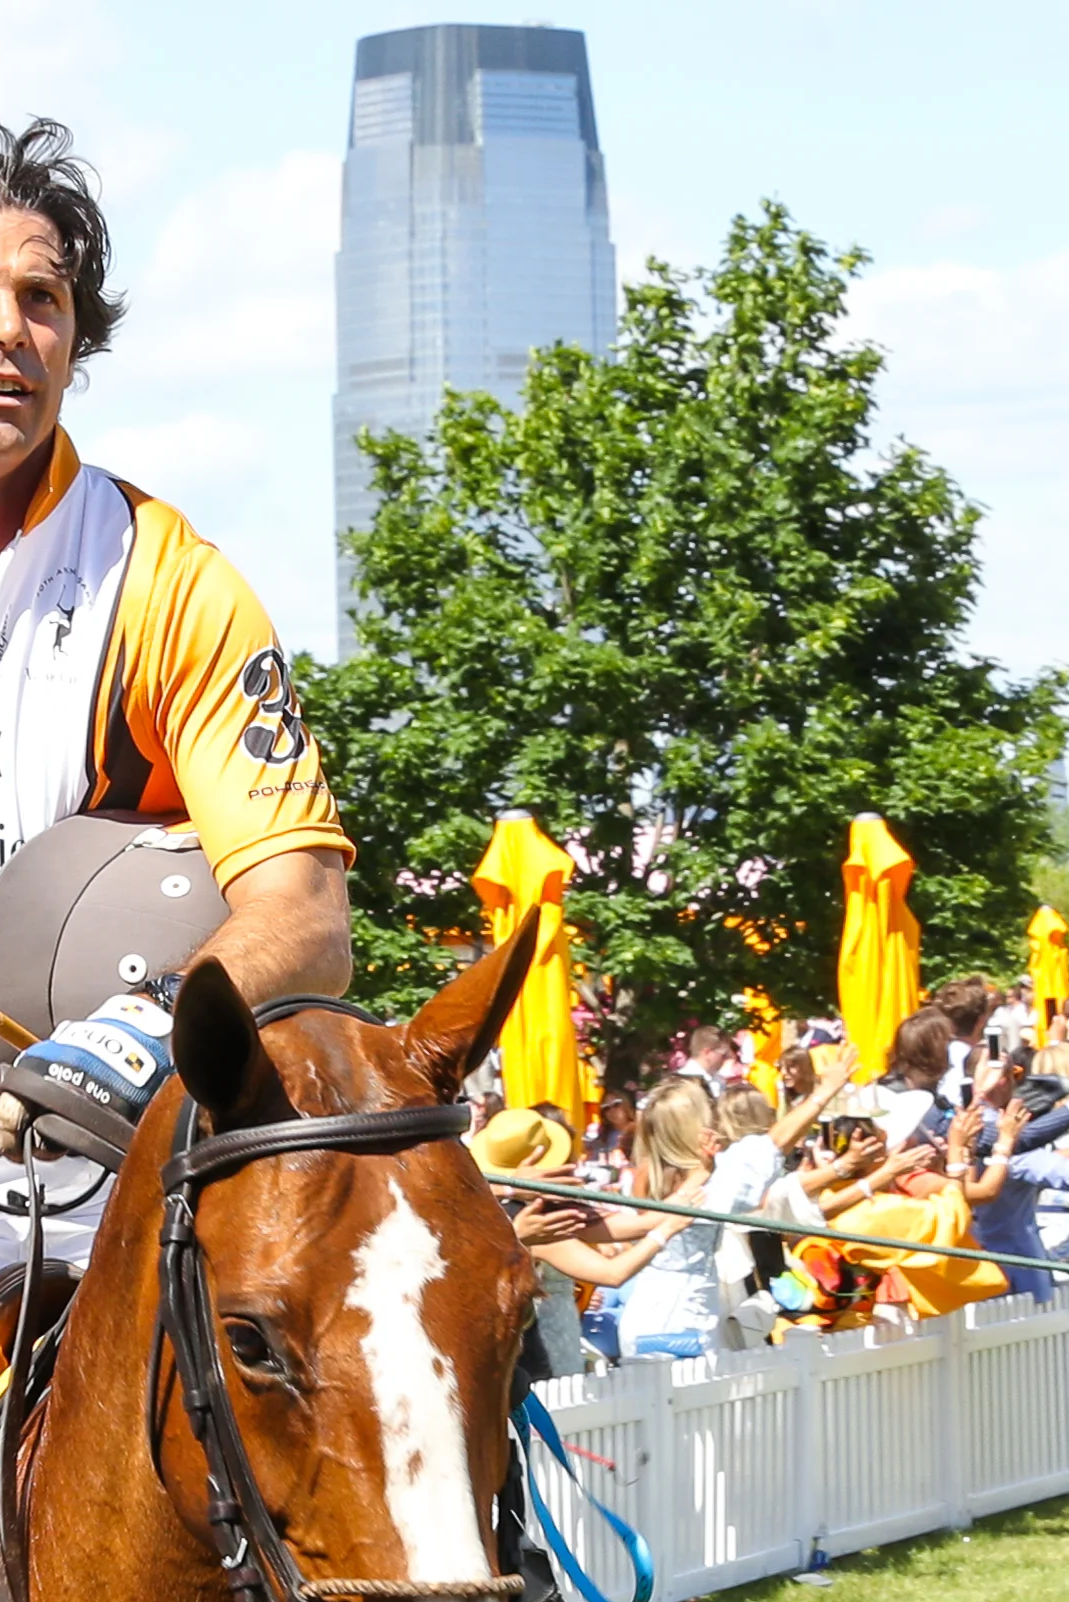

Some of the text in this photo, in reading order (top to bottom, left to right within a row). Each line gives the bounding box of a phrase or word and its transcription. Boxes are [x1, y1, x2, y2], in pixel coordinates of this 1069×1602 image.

[241, 647, 308, 767] 3
[48, 1063, 111, 1104] ona polo
